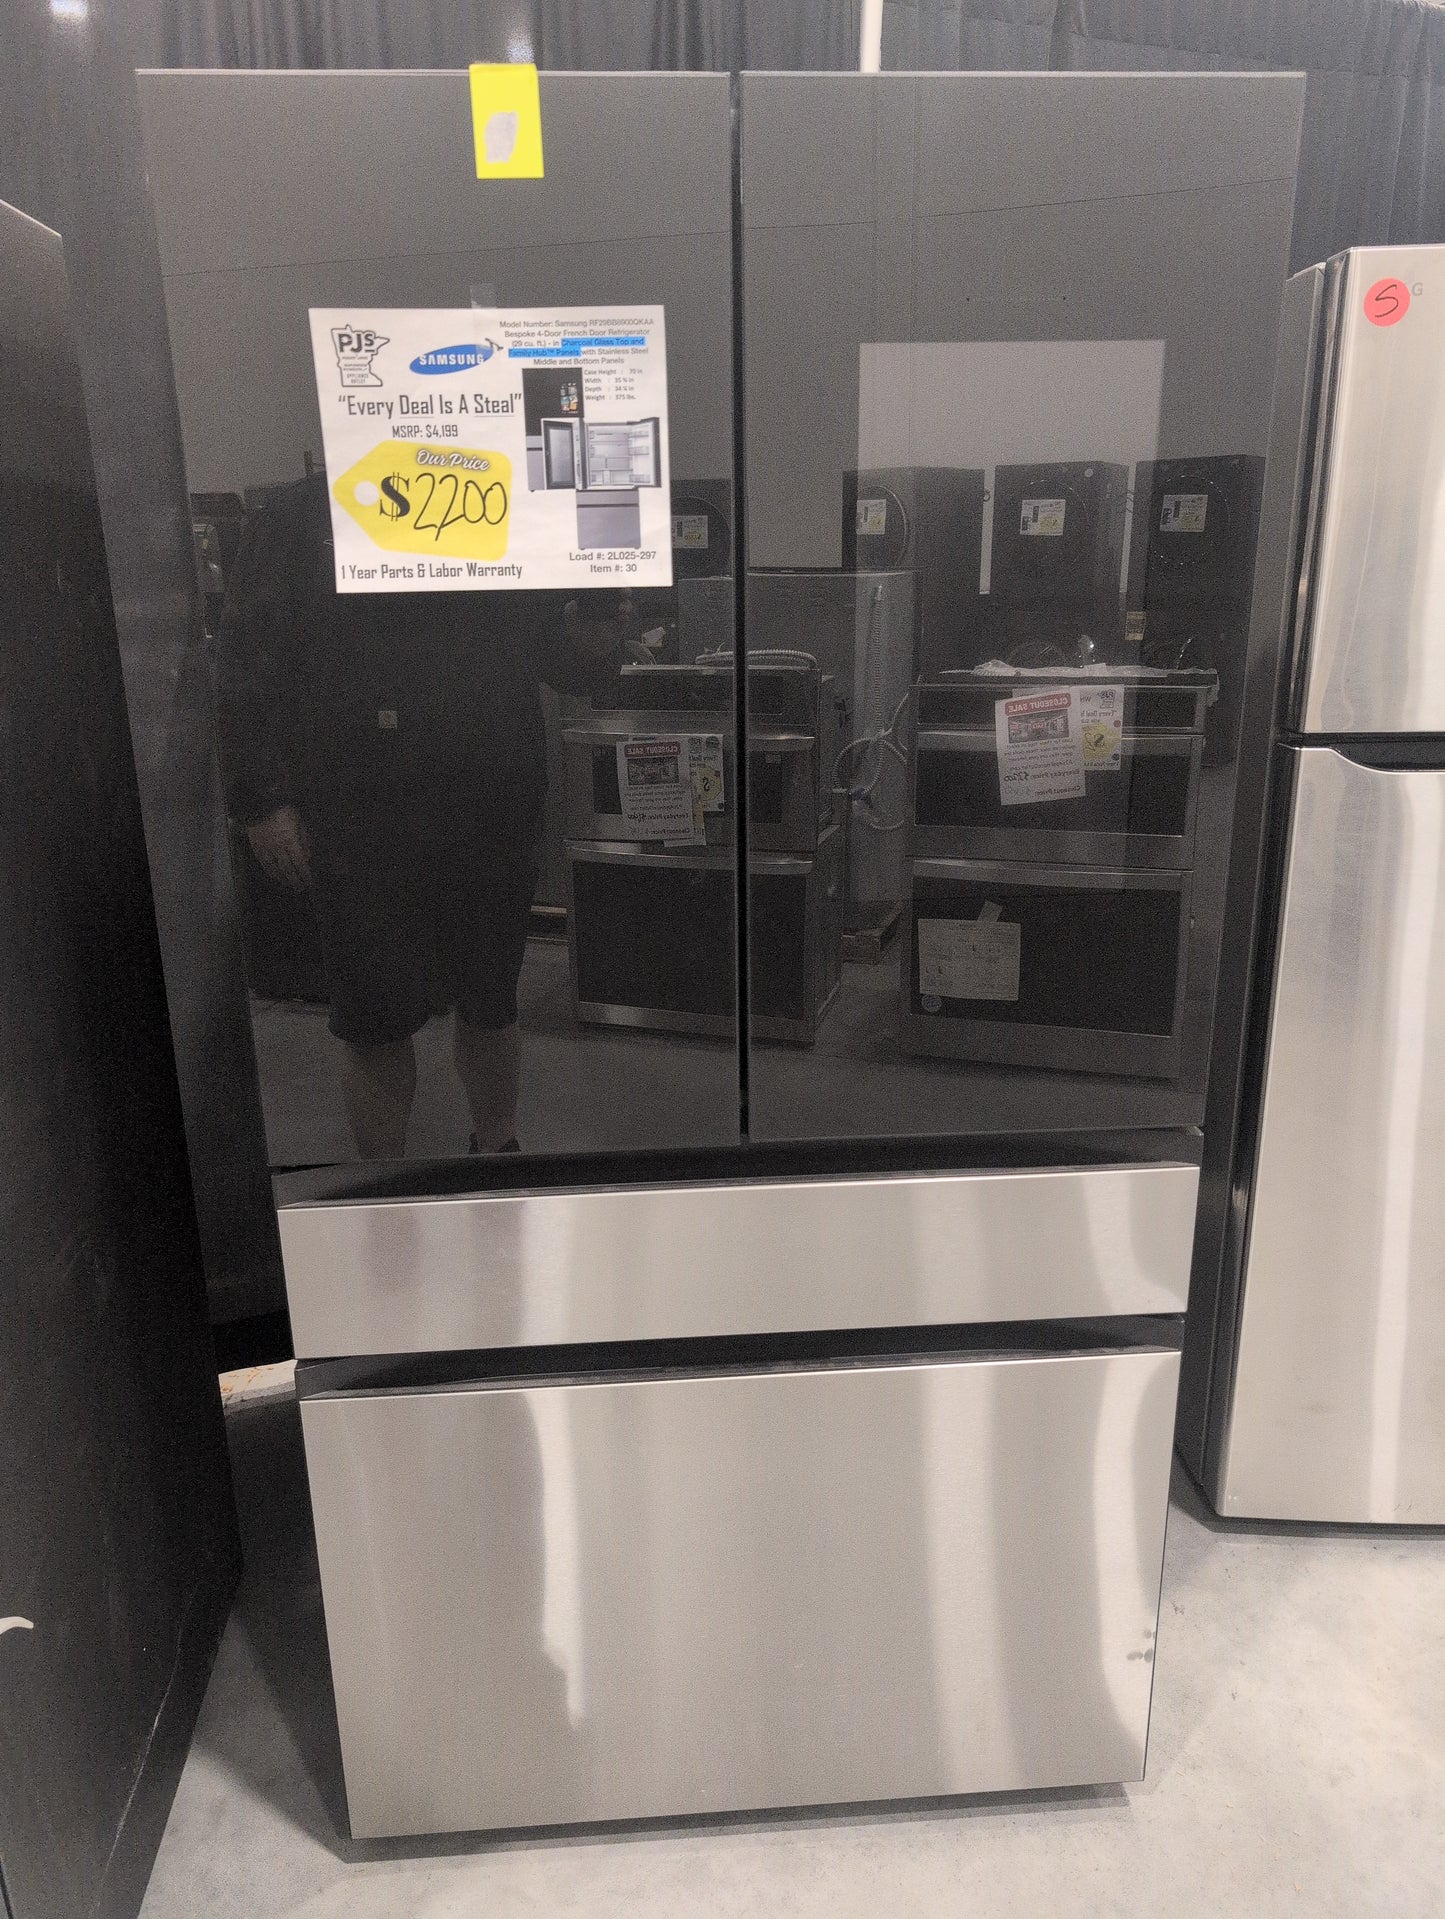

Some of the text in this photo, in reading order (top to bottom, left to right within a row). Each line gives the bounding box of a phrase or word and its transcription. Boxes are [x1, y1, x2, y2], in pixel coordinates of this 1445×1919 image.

[499, 320, 521, 328] Model
[524, 320, 554, 328] Number:
[555, 319, 587, 328] Samsung
[504, 330, 536, 338] Bespoke
[563, 329, 587, 337] French
[608, 328, 650, 337] Refrigerator
[512, 340, 523, 348] (29
[561, 339, 592, 347] Charcoal
[594, 338, 614, 347] Glass
[616, 338, 630, 347] Top
[631, 337, 645, 346] and
[557, 347, 580, 356] Panels
[598, 347, 630, 355] Stainless
[631, 346, 649, 354] Steel
[419, 353, 485, 366] SAMSUNG
[601, 357, 625, 365] Panels
[399, 394, 434, 415] Deal
[439, 394, 453, 415] Is
[459, 393, 469, 414] A
[392, 424, 459, 438] MSRP: $4,199
[416, 450, 490, 471] Our Price
[569, 550, 657, 561] Load #: 2L025-297
[341, 562, 523, 579] 1 Year Parts & Labor Warranty
[590, 563, 637, 573] Item #: 30
